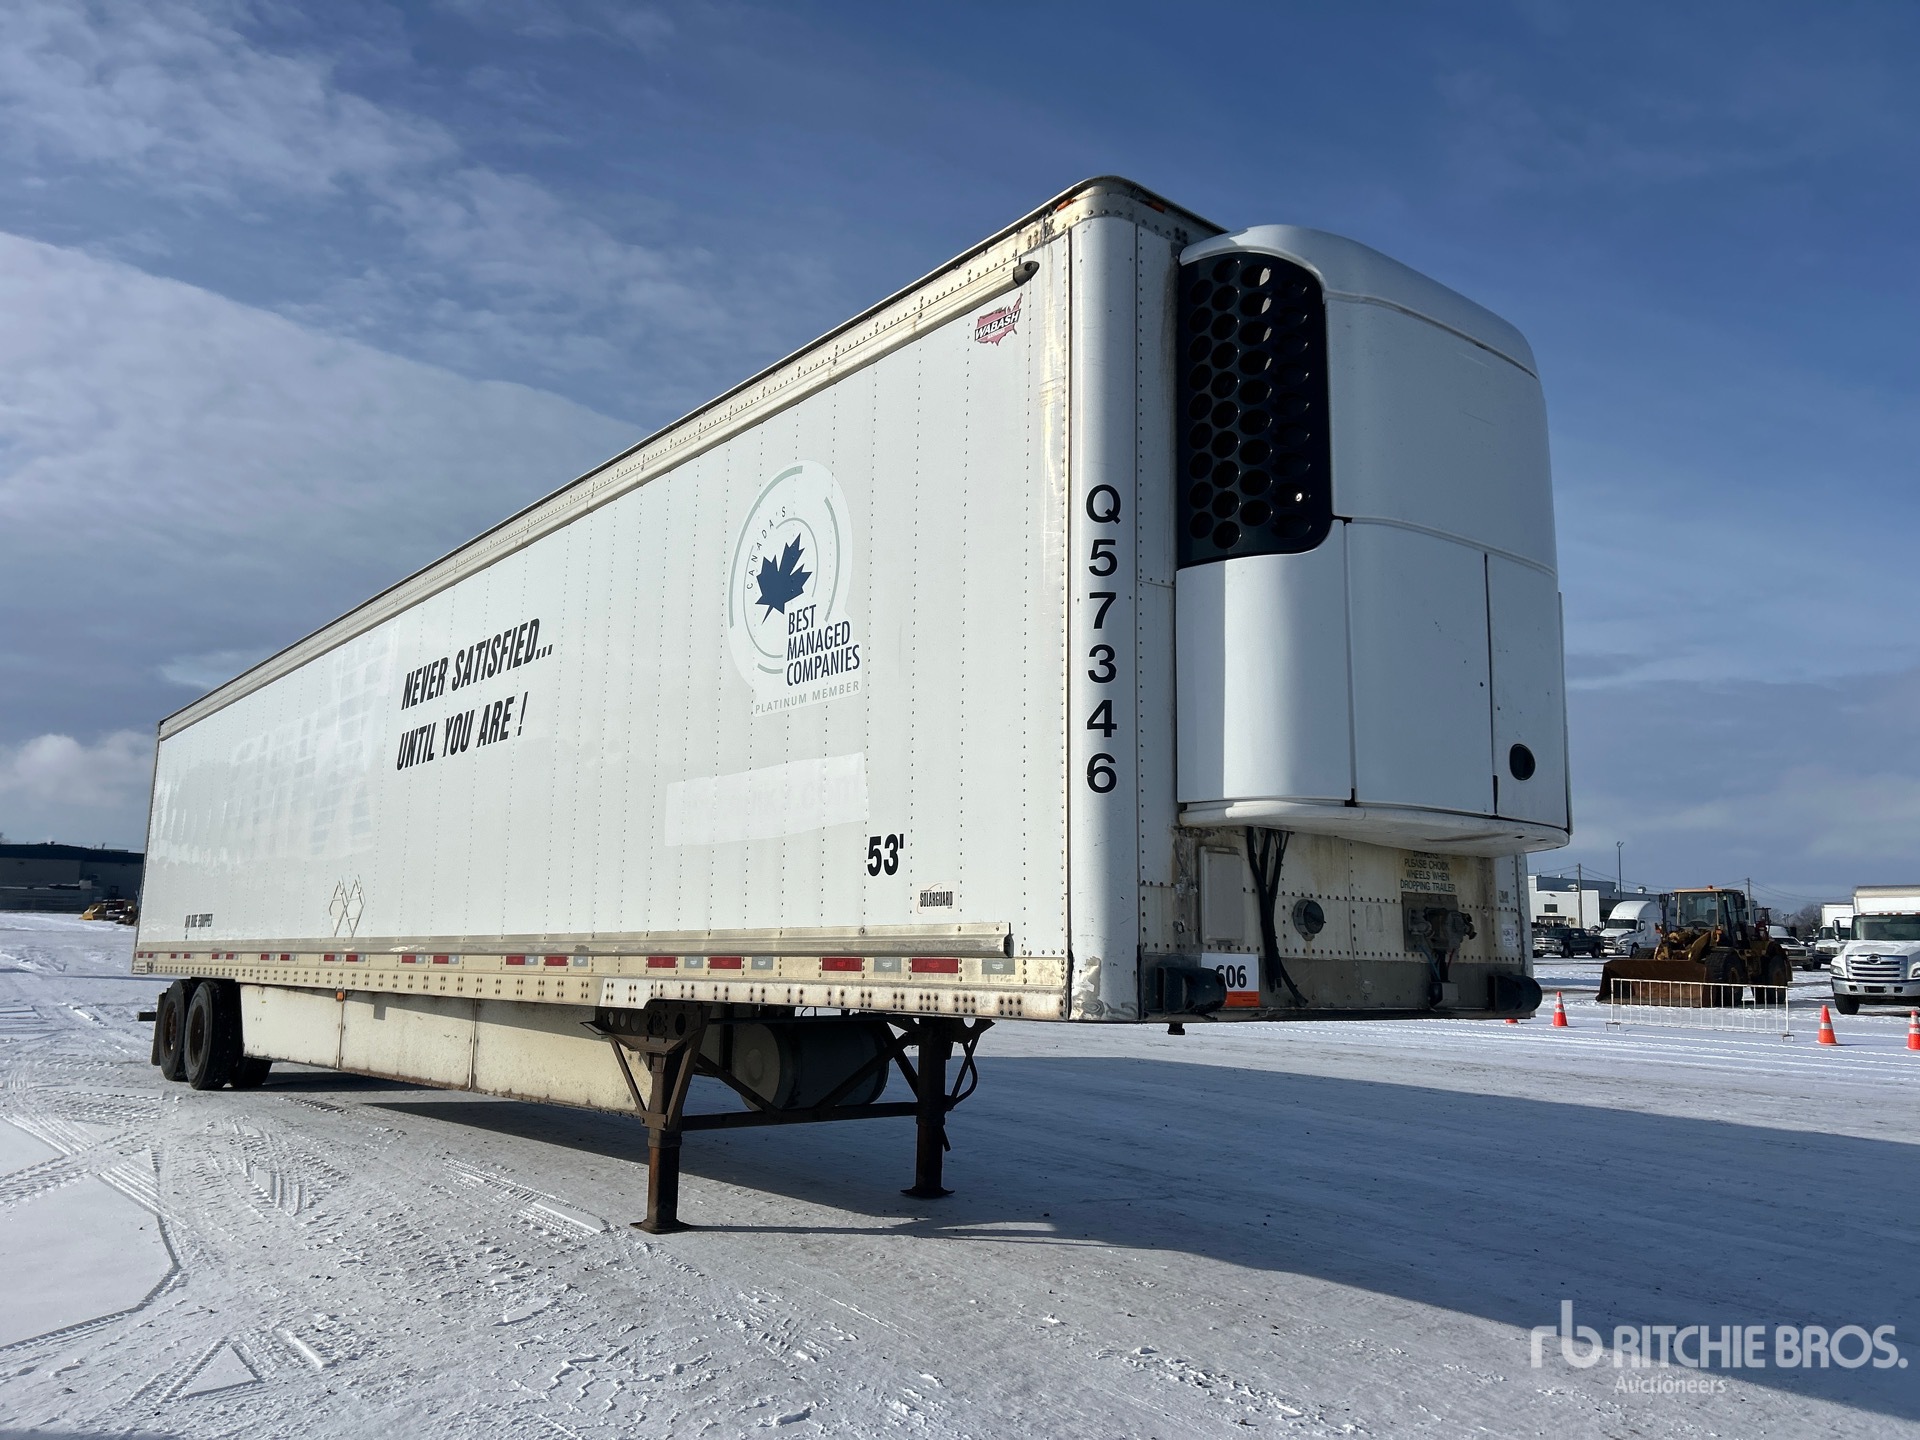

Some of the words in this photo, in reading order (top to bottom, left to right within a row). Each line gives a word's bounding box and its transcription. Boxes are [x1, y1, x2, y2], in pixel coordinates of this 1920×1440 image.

[975, 310, 1020, 340] WABASH
[788, 604, 817, 636] BEST
[787, 620, 851, 661] MANAGED
[401, 657, 448, 710] NEVER
[452, 618, 553, 691] SATISFIED...
[786, 644, 860, 687] COMPANIES
[755, 693, 807, 714] PLATINUM
[812, 681, 859, 701] MEMBER
[397, 722, 436, 771] UNTIL
[442, 709, 475, 757] YOU
[476, 696, 515, 748] ARE
[867, 833, 904, 877] 53'
[1404, 858, 1428, 869] PLEASE
[1400, 879, 1431, 891] DROPPING
[1432, 882, 1456, 892] TRAILER
[1406, 869, 1431, 880] WHEELS
[1432, 871, 1450, 881] WHEN
[919, 891, 954, 907] SOLARGUARD
